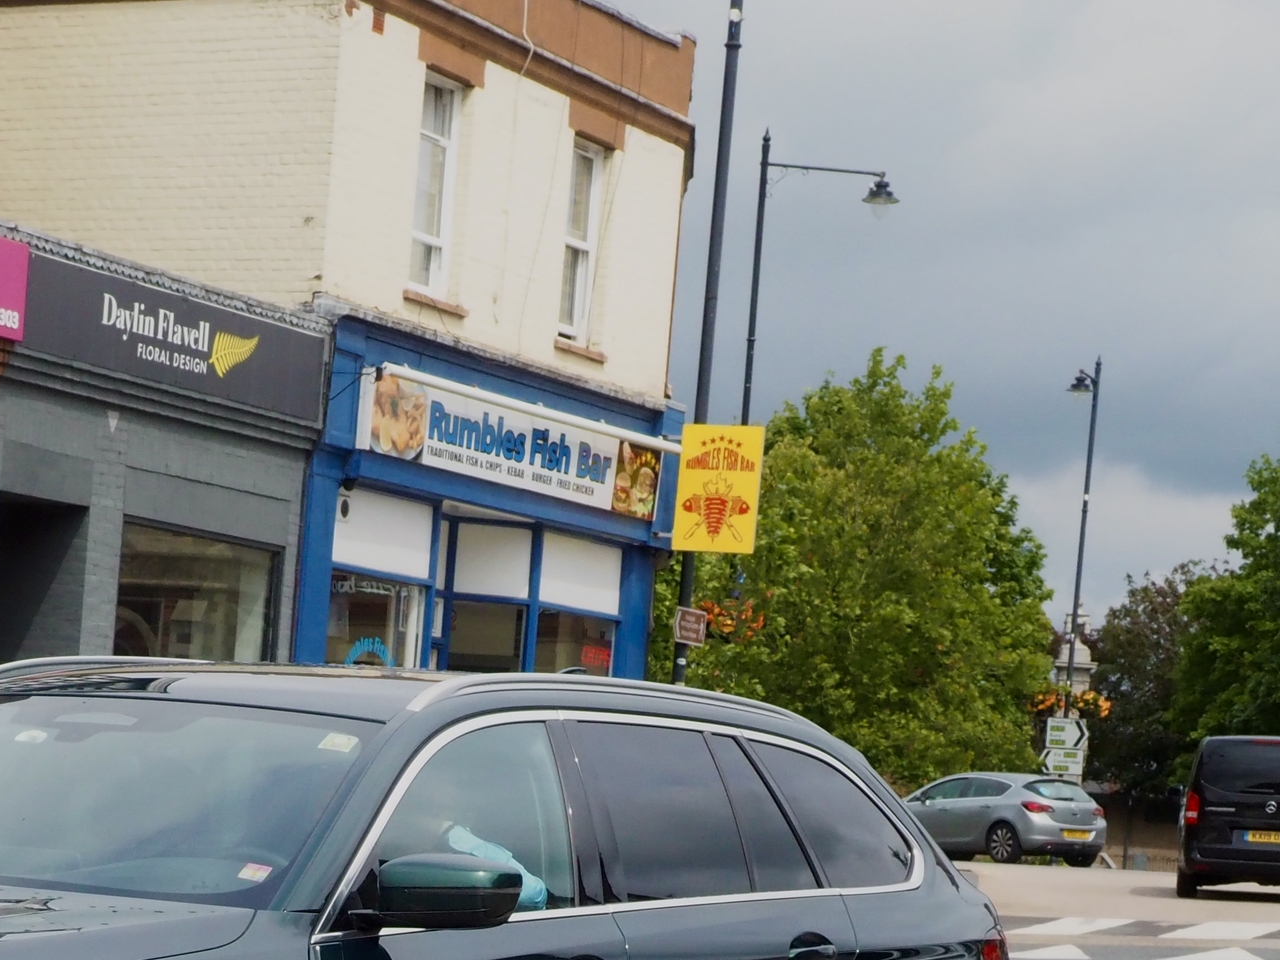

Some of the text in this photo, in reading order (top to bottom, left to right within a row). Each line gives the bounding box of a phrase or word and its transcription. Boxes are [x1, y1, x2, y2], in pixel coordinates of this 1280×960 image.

[102, 293, 210, 352] Daylin Flavell
[137, 343, 207, 375] FLORAL DESIGN
[428, 400, 612, 485] Rumbles Fish Bar
[686, 447, 755, 472] RUMBLES FISH BAR
[426, 445, 464, 464] TRADITIONAL
[466, 456, 479, 468] FISH
[485, 460, 502, 474] CHIPS
[507, 466, 524, 479] KEBAB
[531, 472, 552, 486] BURGER
[556, 478, 571, 491] FRIED
[572, 481, 595, 496] CHICKEN
